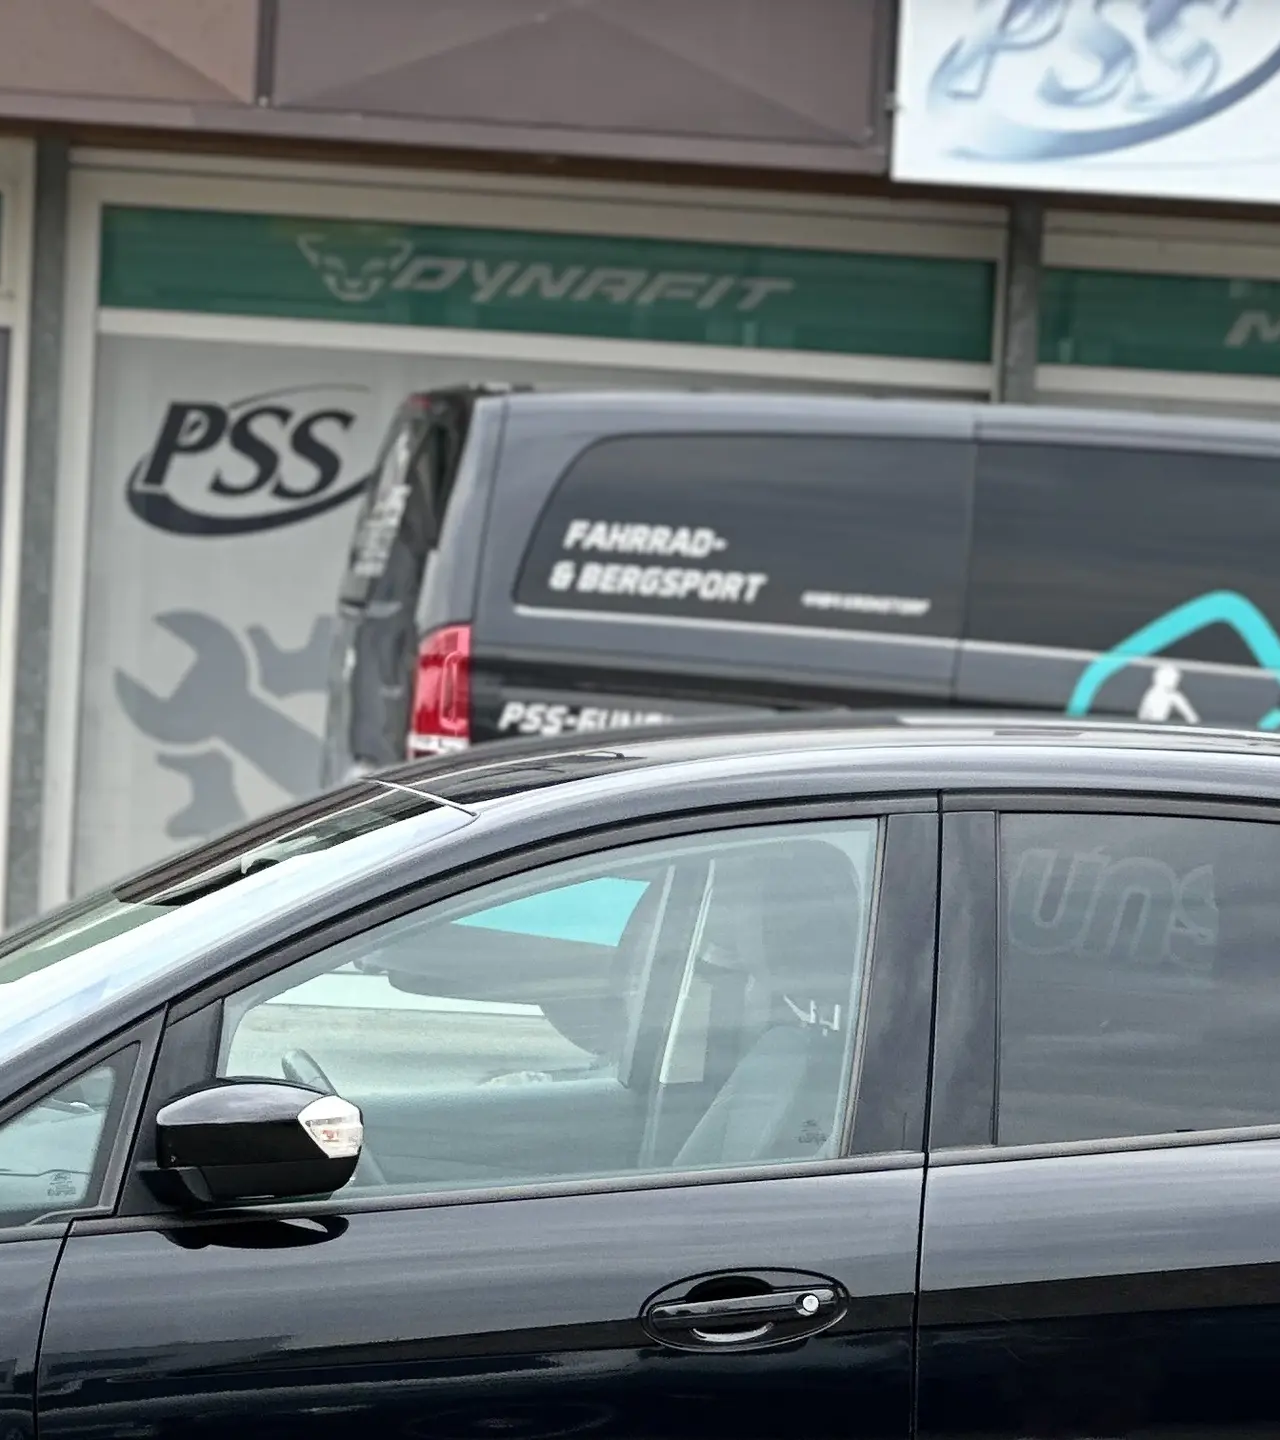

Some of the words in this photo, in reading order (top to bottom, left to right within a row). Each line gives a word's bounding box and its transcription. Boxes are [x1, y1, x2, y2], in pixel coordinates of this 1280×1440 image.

[394, 257, 794, 310] DYNAFIT
[142, 401, 356, 500] PSS
[564, 520, 727, 559] FAHRRAD-
[549, 560, 575, 591] &
[580, 564, 766, 605] BERGSPORT
